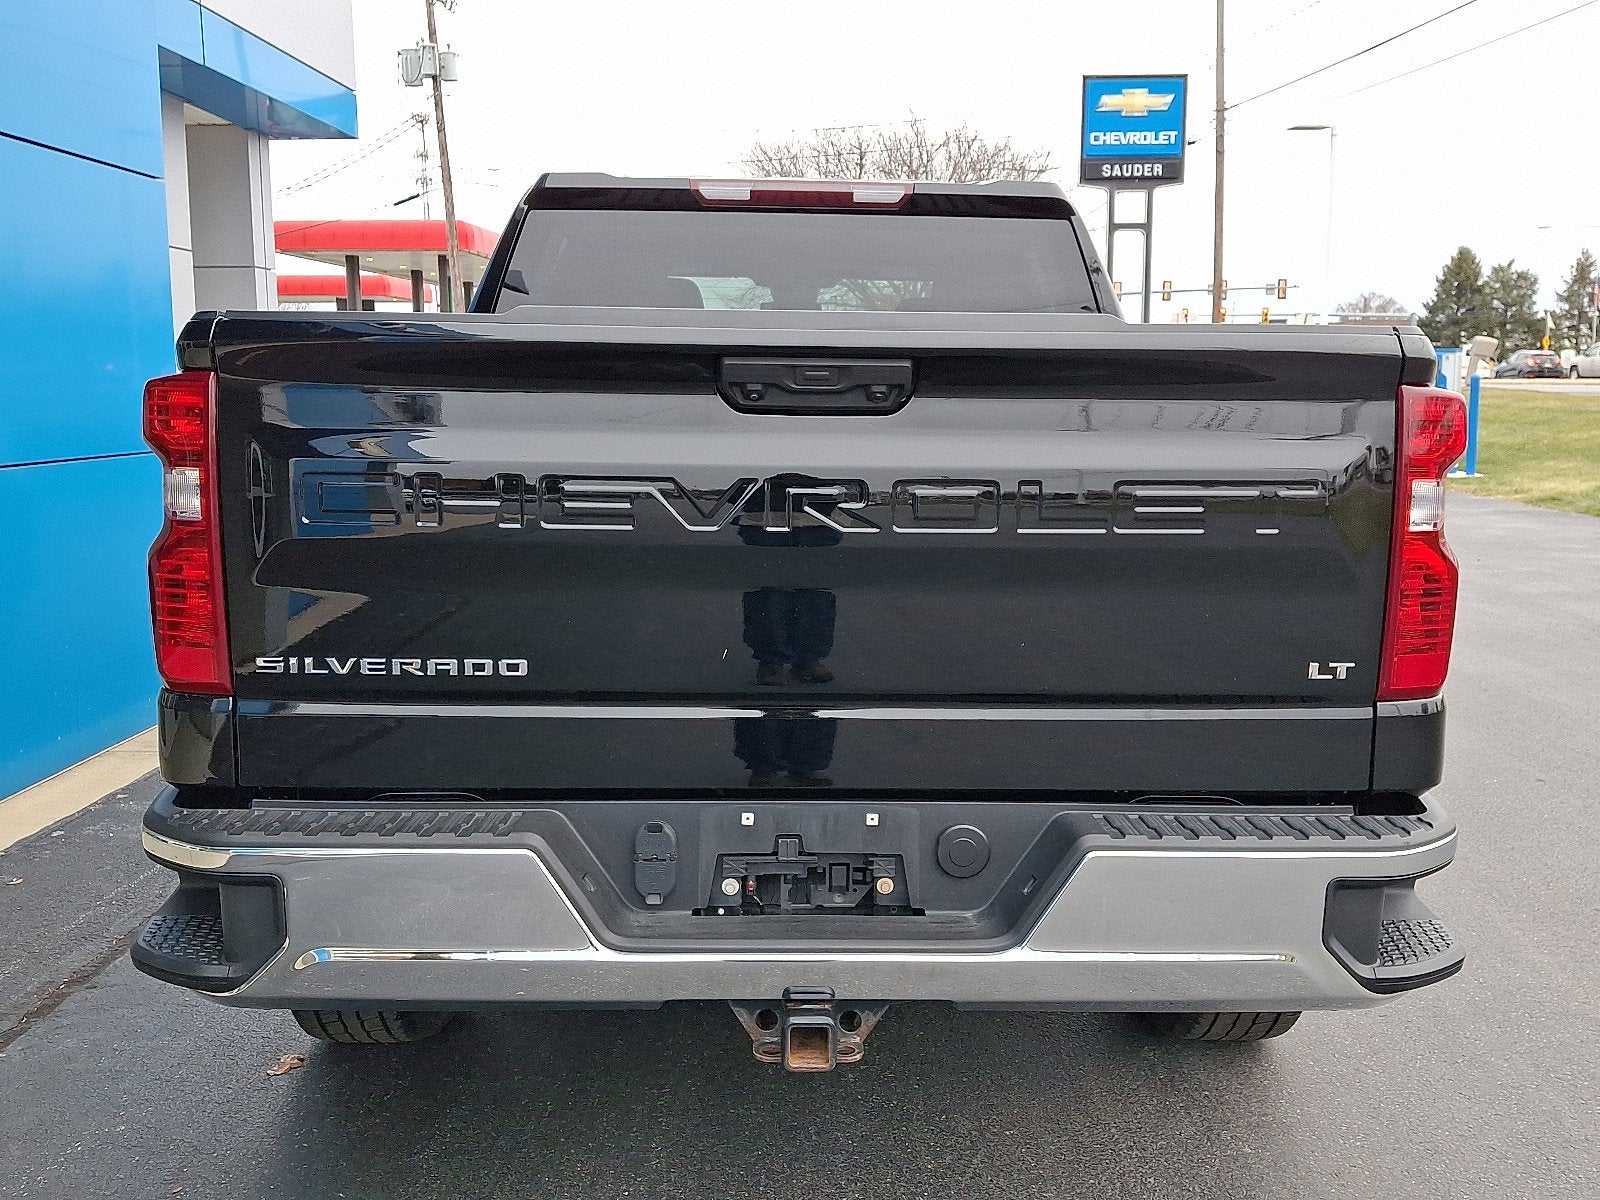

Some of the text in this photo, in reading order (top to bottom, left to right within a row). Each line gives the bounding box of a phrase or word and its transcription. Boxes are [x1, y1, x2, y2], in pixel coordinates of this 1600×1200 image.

[1089, 130, 1178, 145] CHEVROLET
[1101, 163, 1163, 177] SAUDER
[300, 471, 1322, 535] CHEVROLET
[255, 656, 528, 676] SILVERADO
[1308, 662, 1355, 680] LT
